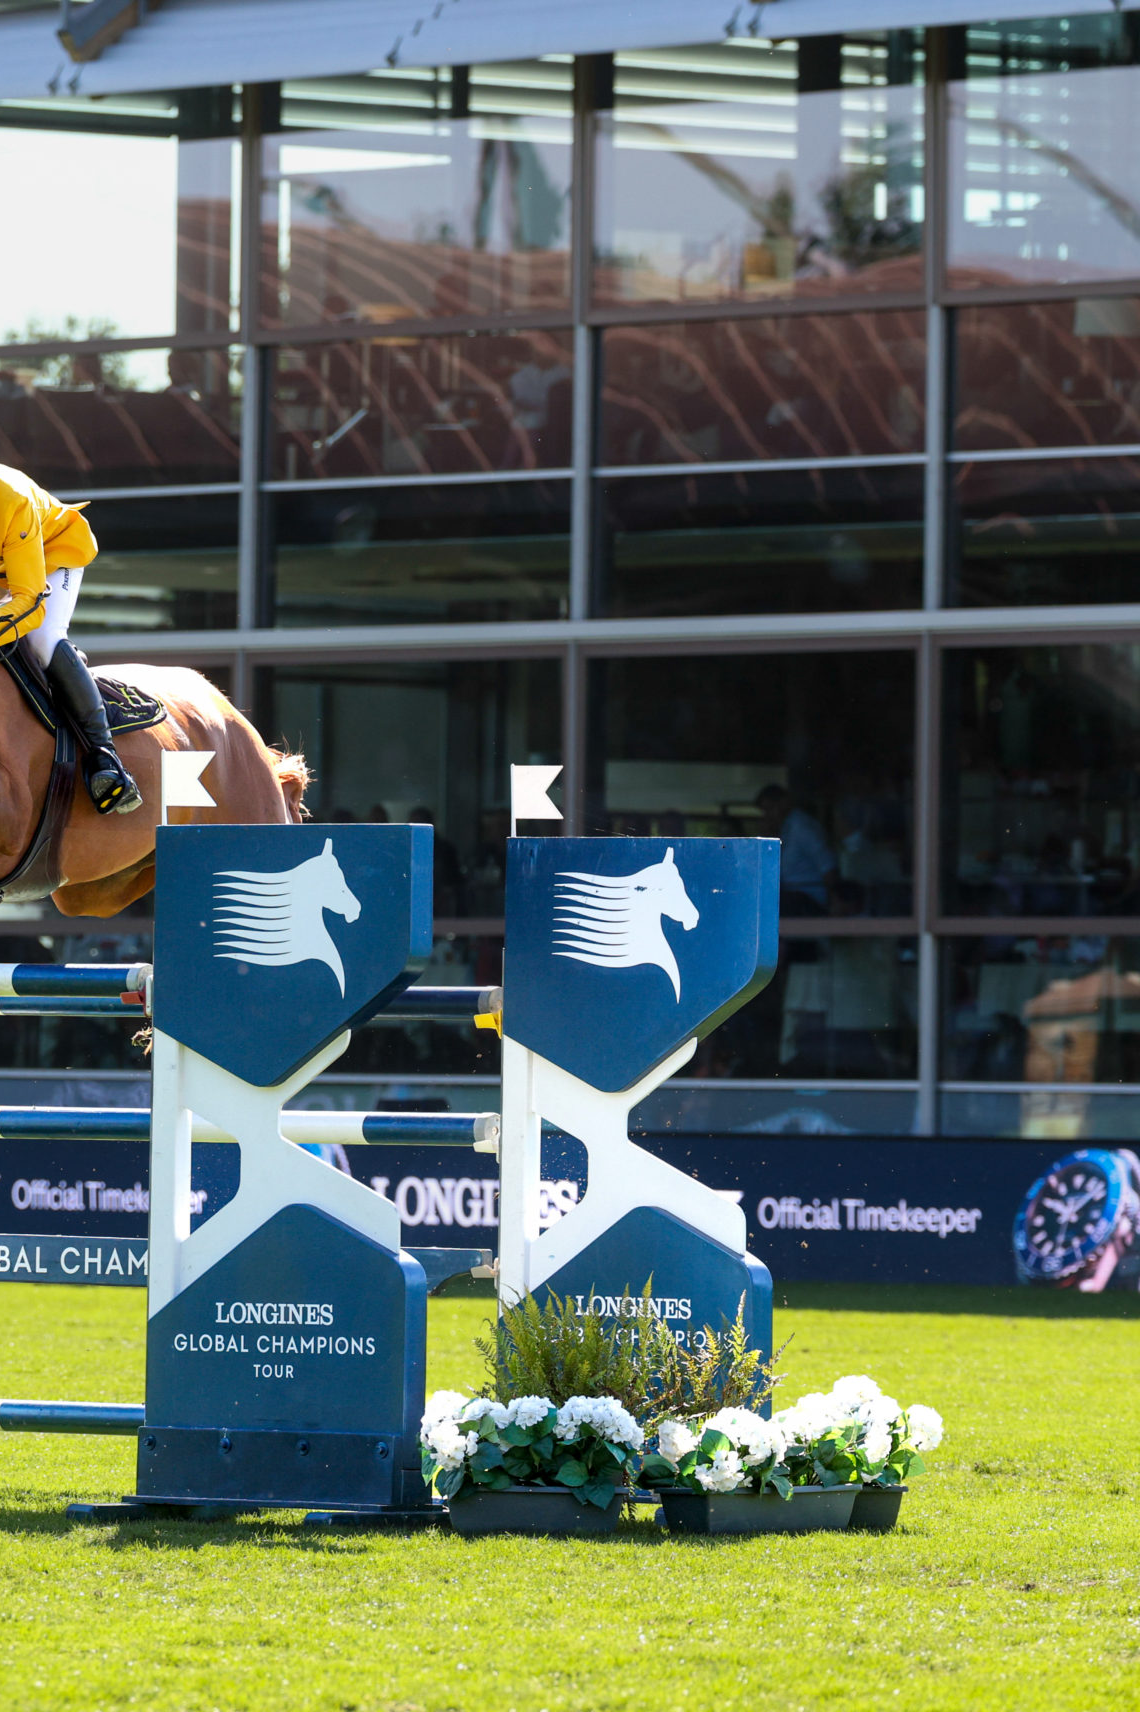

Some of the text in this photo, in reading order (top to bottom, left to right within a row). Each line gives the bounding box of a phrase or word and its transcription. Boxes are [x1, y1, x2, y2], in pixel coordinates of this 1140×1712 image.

[11, 1178, 84, 1211] Official
[757, 1196, 982, 1238] Official Timekeeper
[215, 1301, 334, 1326] LONGINES
[576, 1295, 692, 1320] LONGINES
[174, 1333, 376, 1356] GLOBAL CHAMPIONS
[253, 1363, 294, 1379] TOUR
